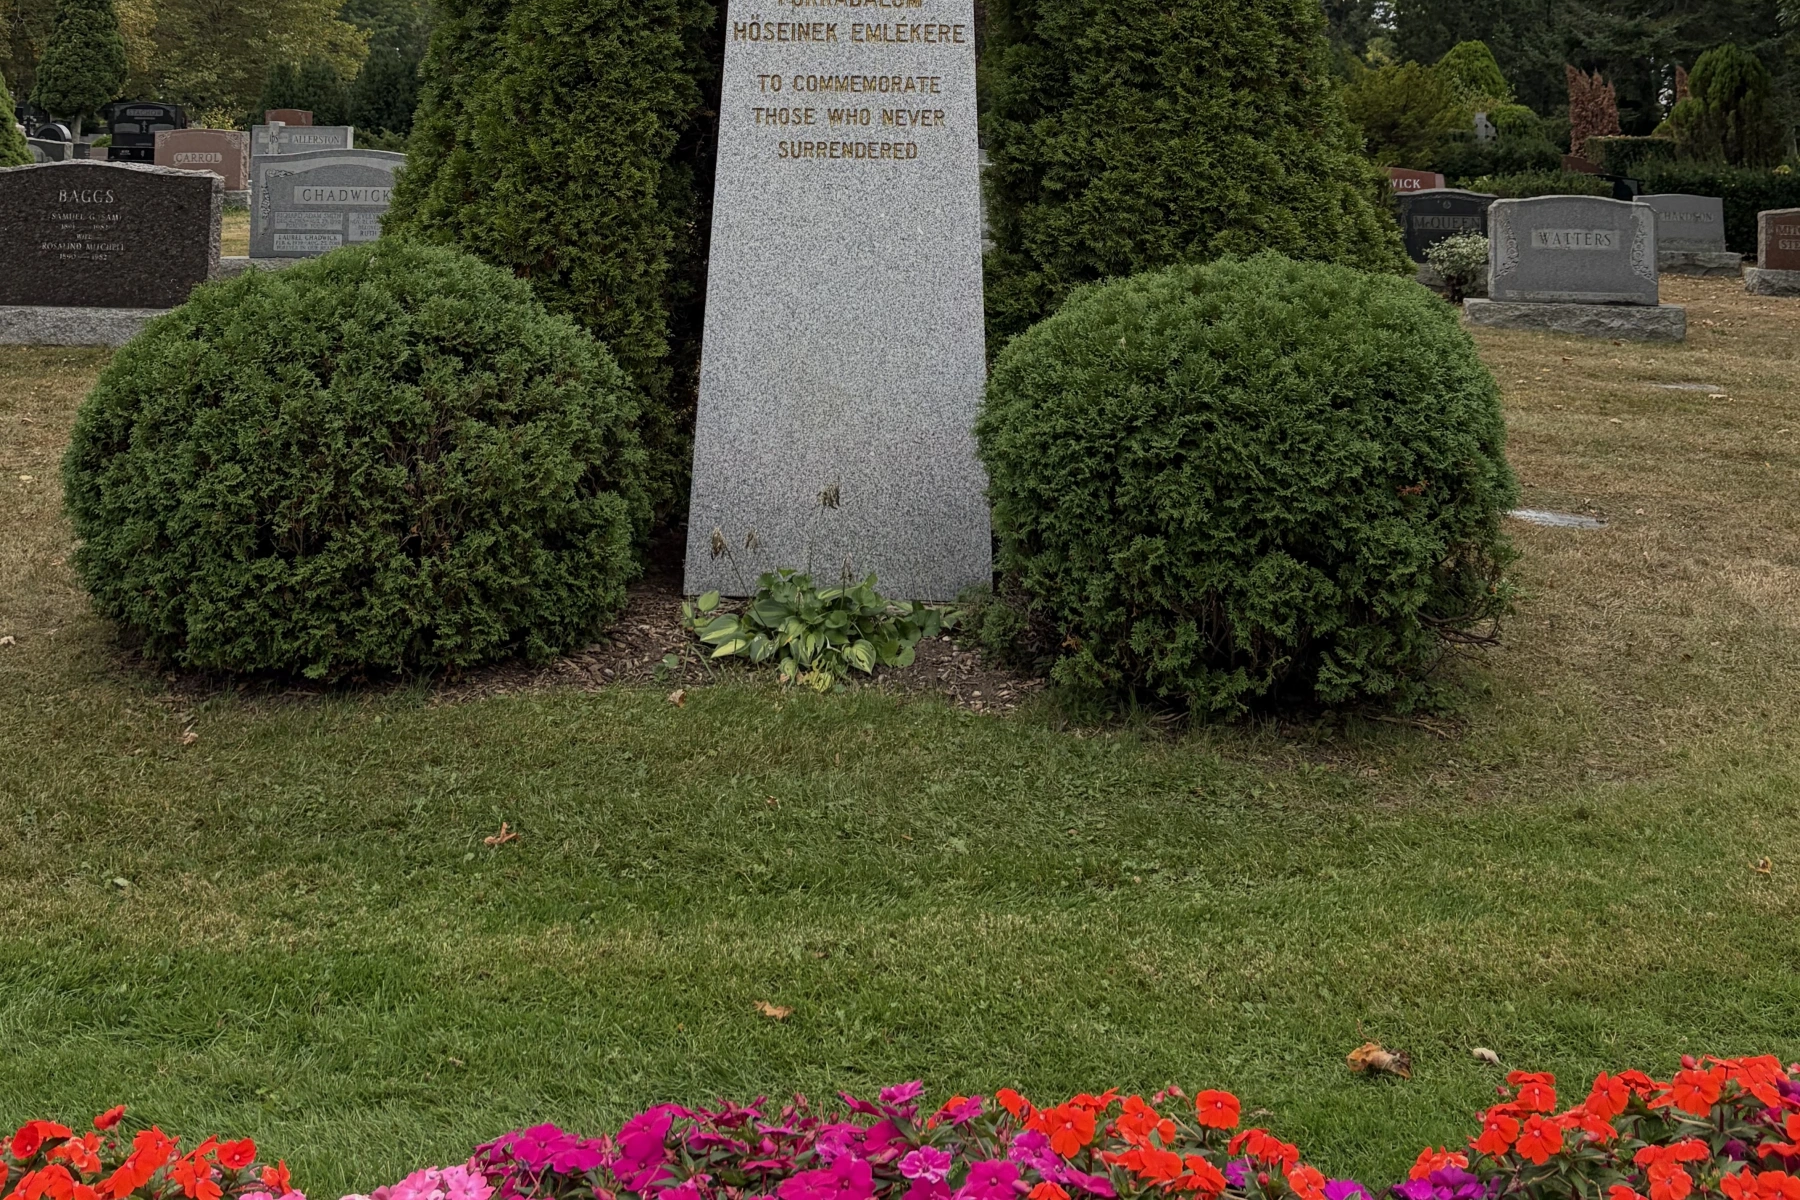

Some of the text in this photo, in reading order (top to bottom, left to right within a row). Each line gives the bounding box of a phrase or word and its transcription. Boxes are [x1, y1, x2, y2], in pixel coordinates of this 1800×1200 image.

[757, 74, 941, 93] TO COMMEMORATE
[752, 108, 945, 127] THOSE WHO NEVER
[293, 135, 340, 144] ALLERSTON
[175, 153, 220, 163] CARROL
[778, 141, 918, 160] SURRENDERED
[59, 189, 114, 204] BAGGS
[302, 189, 391, 202] CHADWICK
[1414, 216, 1481, 229] McQUEEN
[1538, 231, 1612, 247] WATTERS
